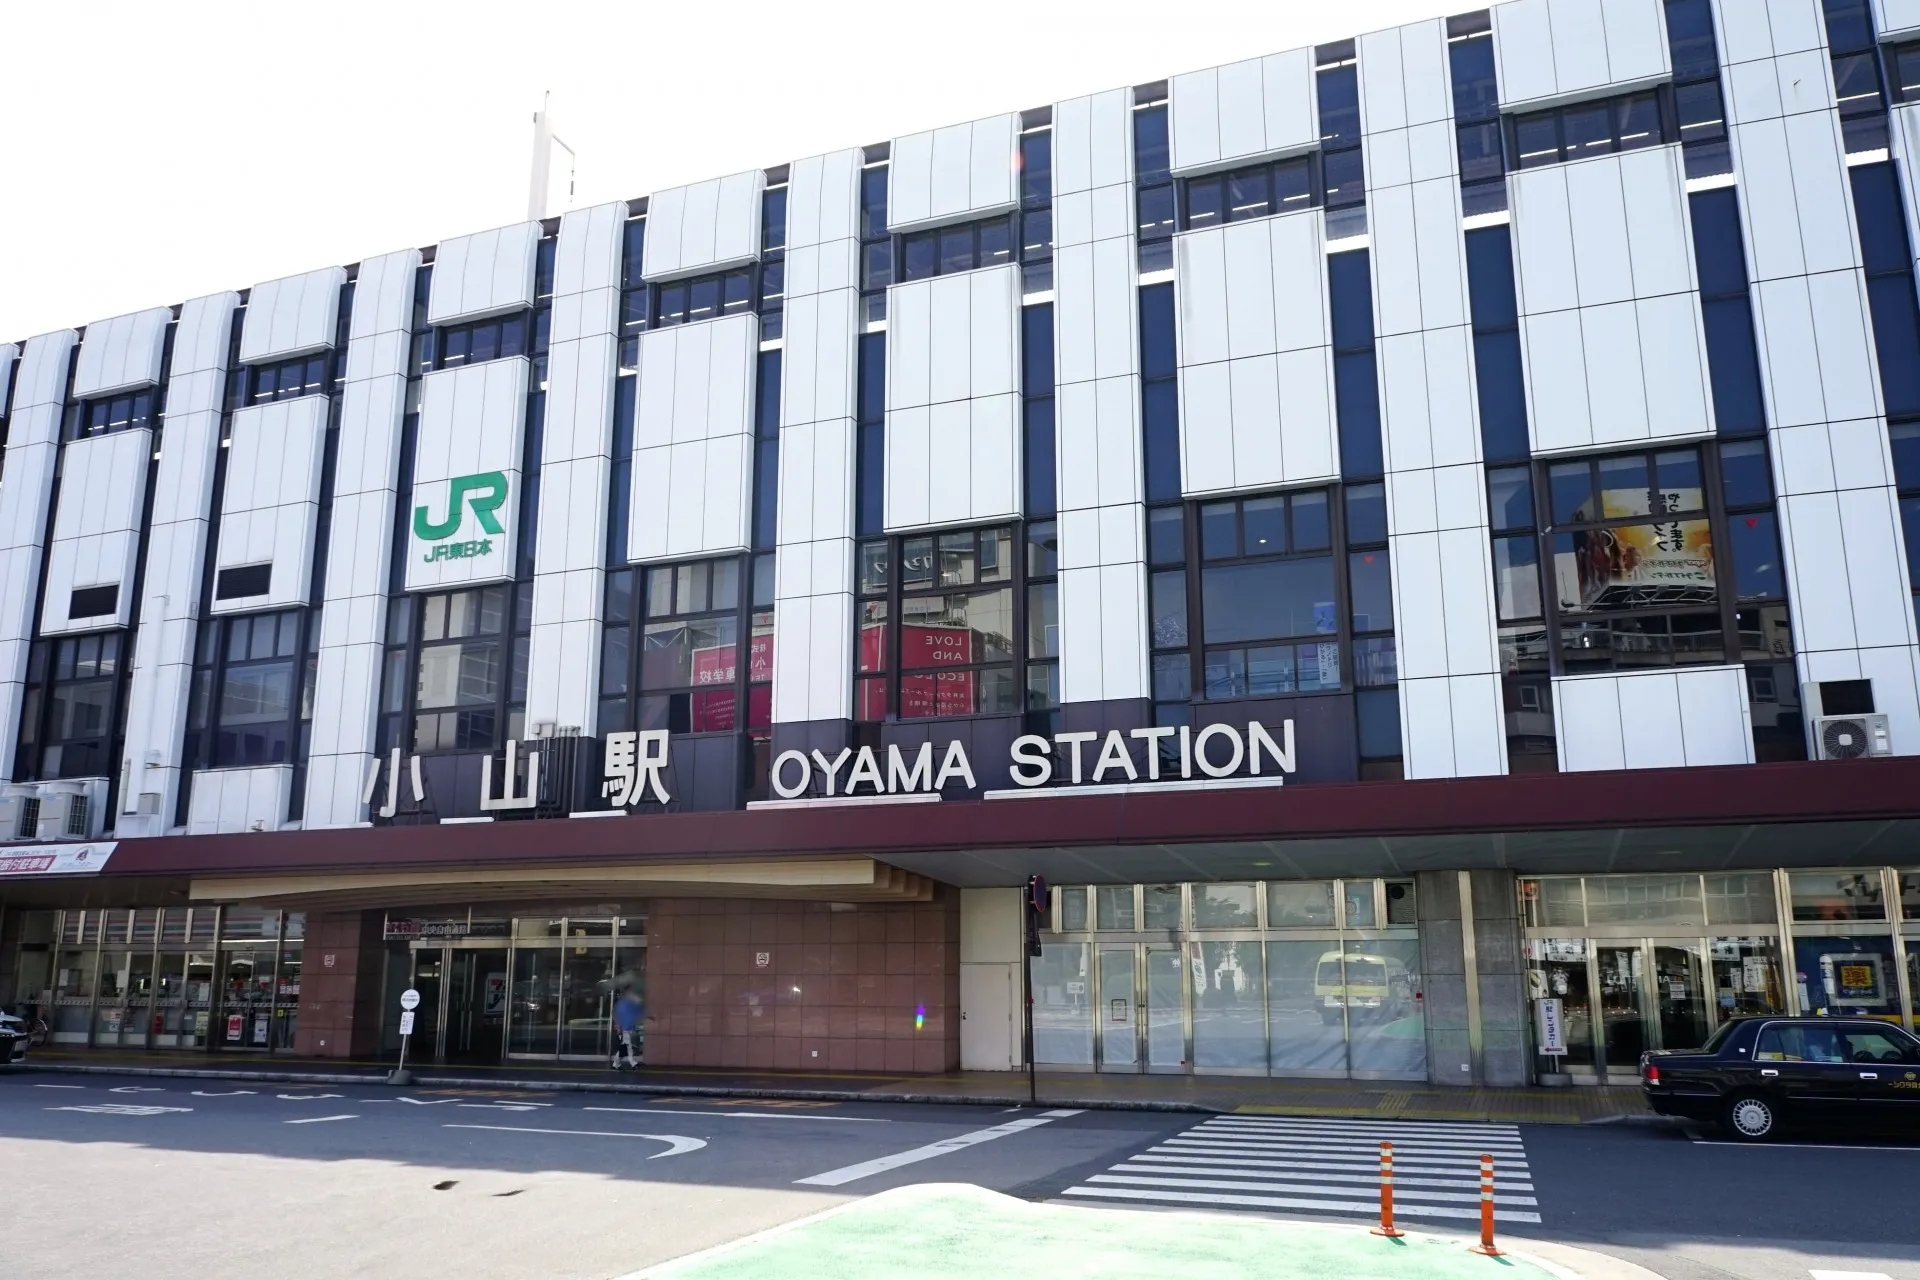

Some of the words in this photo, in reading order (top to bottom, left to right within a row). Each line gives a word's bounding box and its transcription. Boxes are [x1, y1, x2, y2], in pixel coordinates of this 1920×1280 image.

[413, 470, 508, 541] JR
[423, 538, 493, 563] JR東日本
[362, 728, 671, 818] 小山駅
[771, 739, 977, 799] OYAMA
[1009, 718, 1297, 787] STATION
